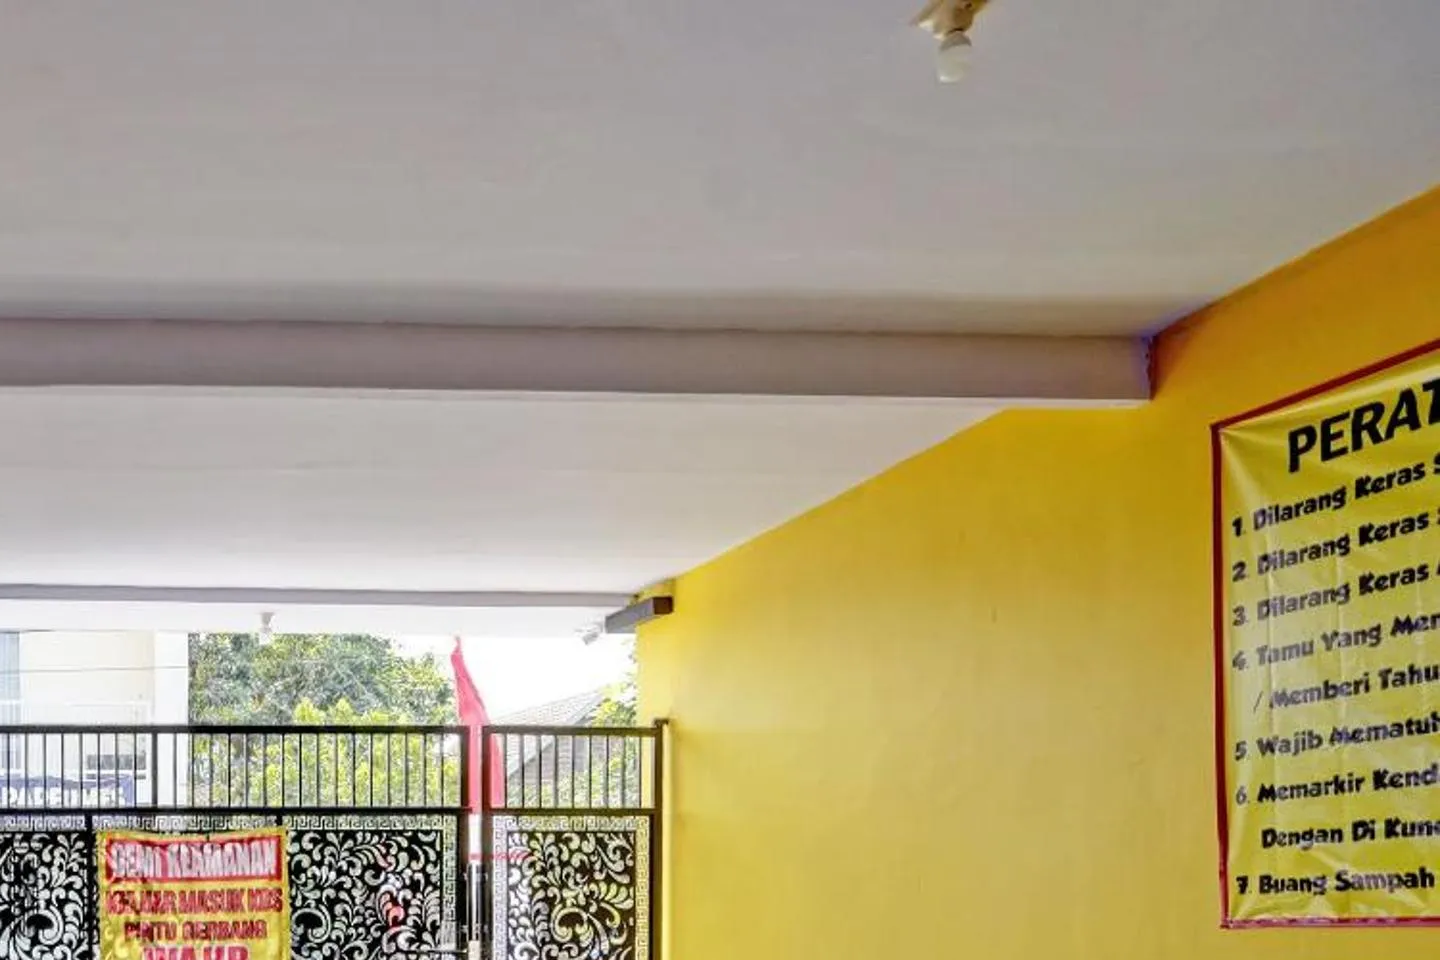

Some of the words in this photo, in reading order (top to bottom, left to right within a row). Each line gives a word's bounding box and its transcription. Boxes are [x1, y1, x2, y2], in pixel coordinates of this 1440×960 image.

[1253, 486, 1347, 531] Dilarang
[1355, 462, 1426, 499] Keras
[1258, 533, 1351, 575] Dilarang
[1358, 512, 1429, 547] Keras
[1257, 582, 1350, 620] Dilarang
[1359, 563, 1429, 596] Keras
[1256, 640, 1314, 666] Tamu
[1321, 624, 1382, 650] Yang
[1269, 672, 1370, 709] Memberi
[1379, 664, 1439, 690] Tahu
[1256, 729, 1323, 756] Wajib
[1257, 773, 1365, 802] Memarkir
[1262, 827, 1343, 850] Dengan
[1352, 820, 1375, 841] Di
[167, 839, 277, 878] KEAMANAN
[1259, 874, 1327, 895] Buang
[1335, 866, 1435, 892] Sampah
